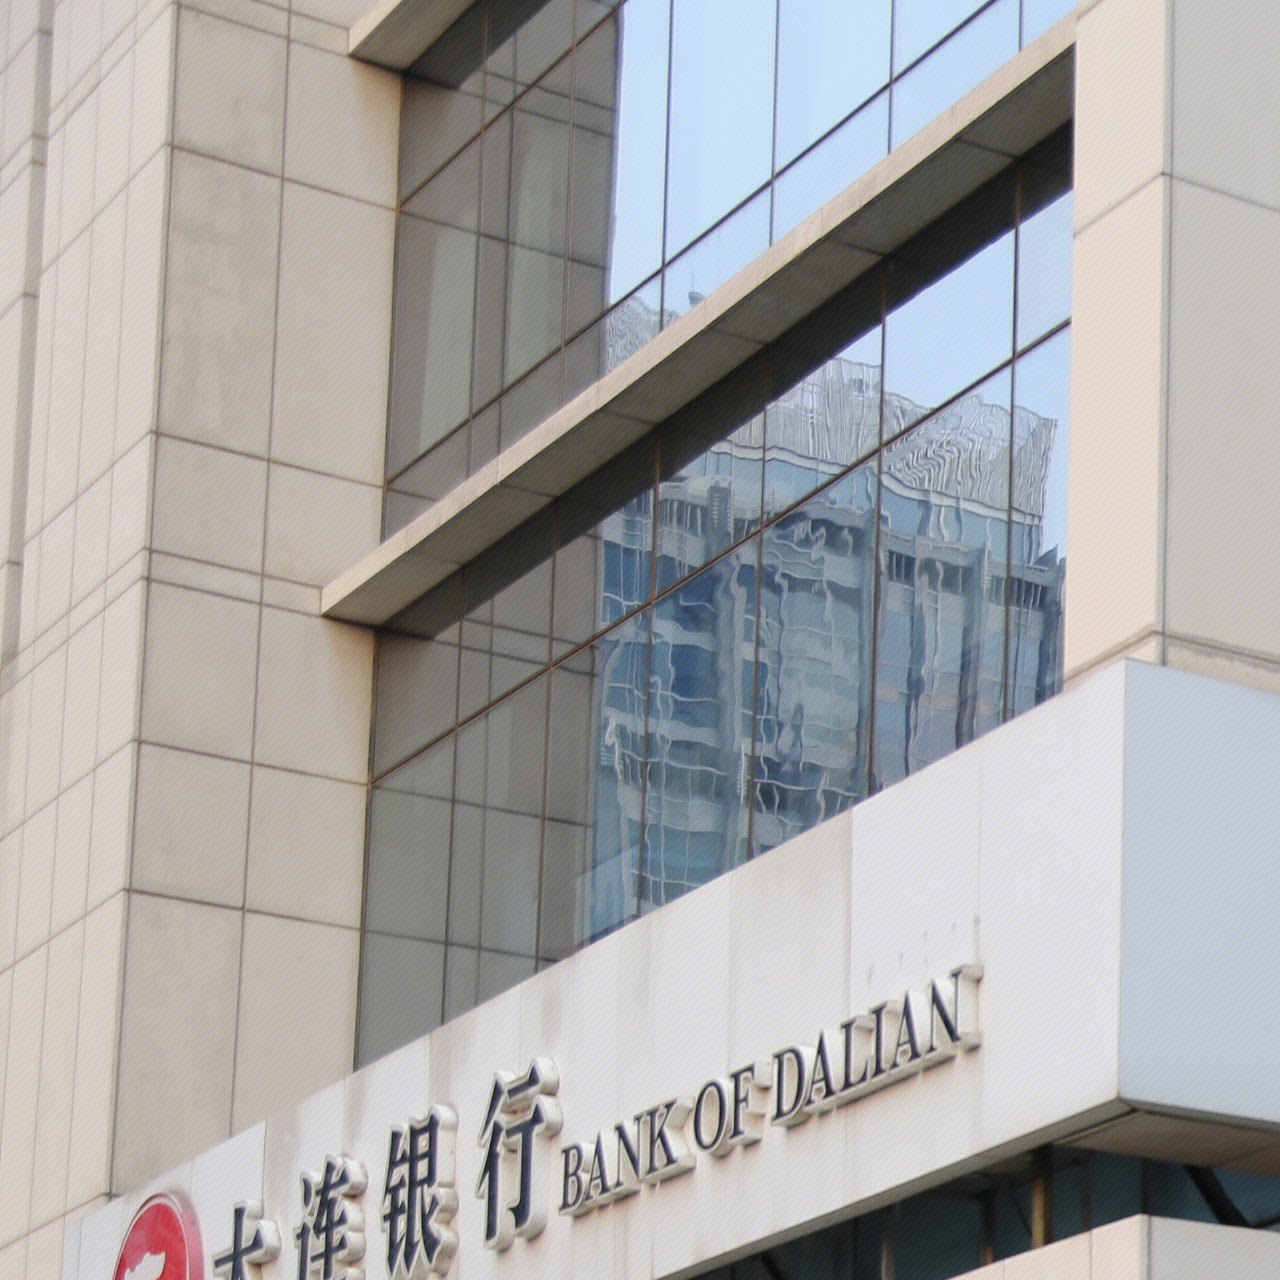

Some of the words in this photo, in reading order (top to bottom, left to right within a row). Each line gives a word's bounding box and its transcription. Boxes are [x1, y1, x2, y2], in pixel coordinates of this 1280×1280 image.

[559, 1099, 679, 1213] BANK
[694, 1063, 756, 1152] OF
[772, 970, 964, 1124] DALIAN
